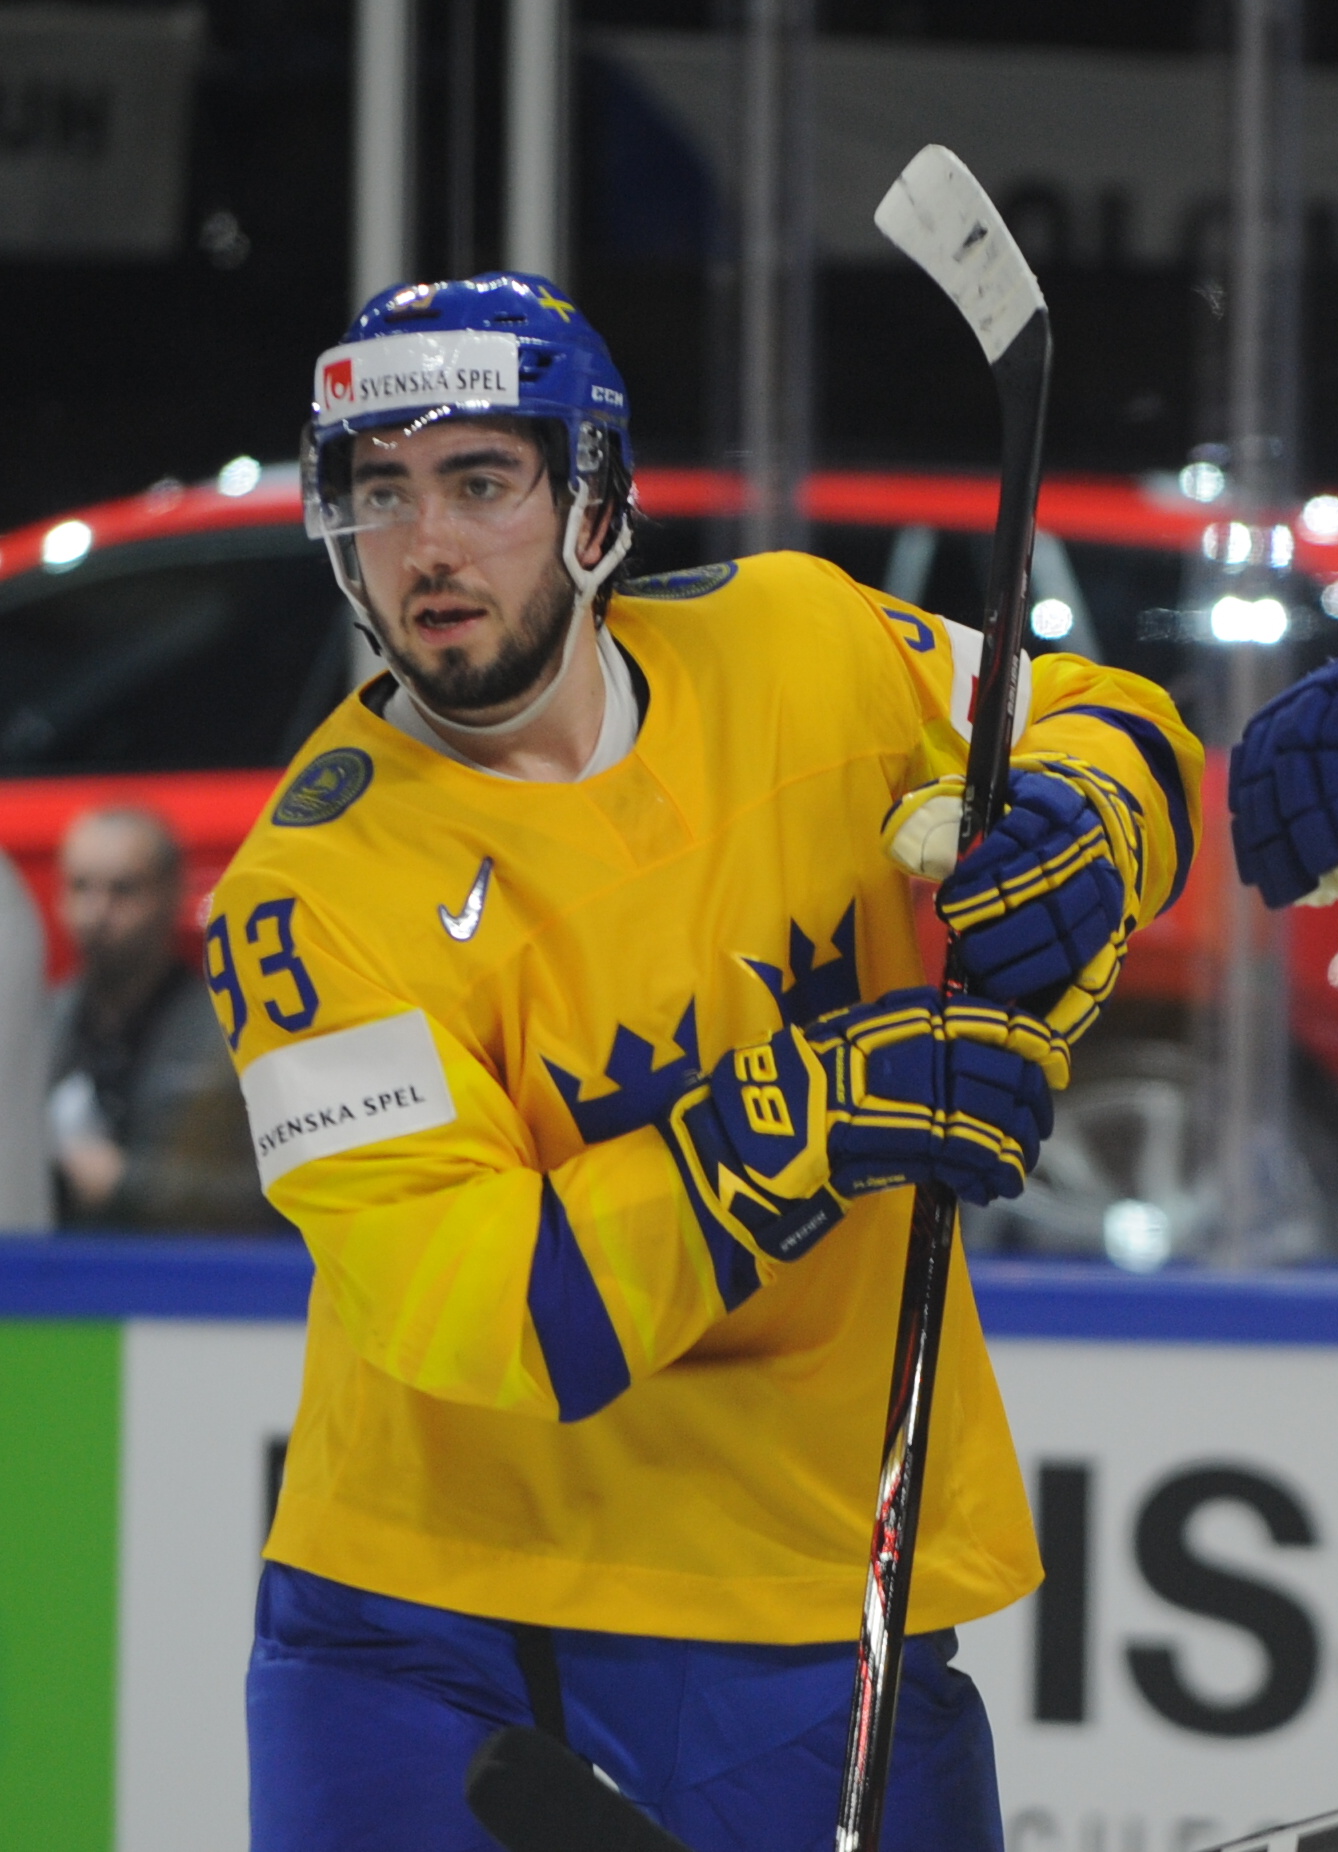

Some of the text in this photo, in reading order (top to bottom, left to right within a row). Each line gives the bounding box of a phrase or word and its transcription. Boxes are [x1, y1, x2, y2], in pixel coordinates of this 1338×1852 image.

[360, 367, 507, 400] SVENSKA SPEL
[591, 384, 624, 408] CCM
[207, 897, 321, 1052] 93
[258, 1084, 427, 1157] SVENSKA SPEL
